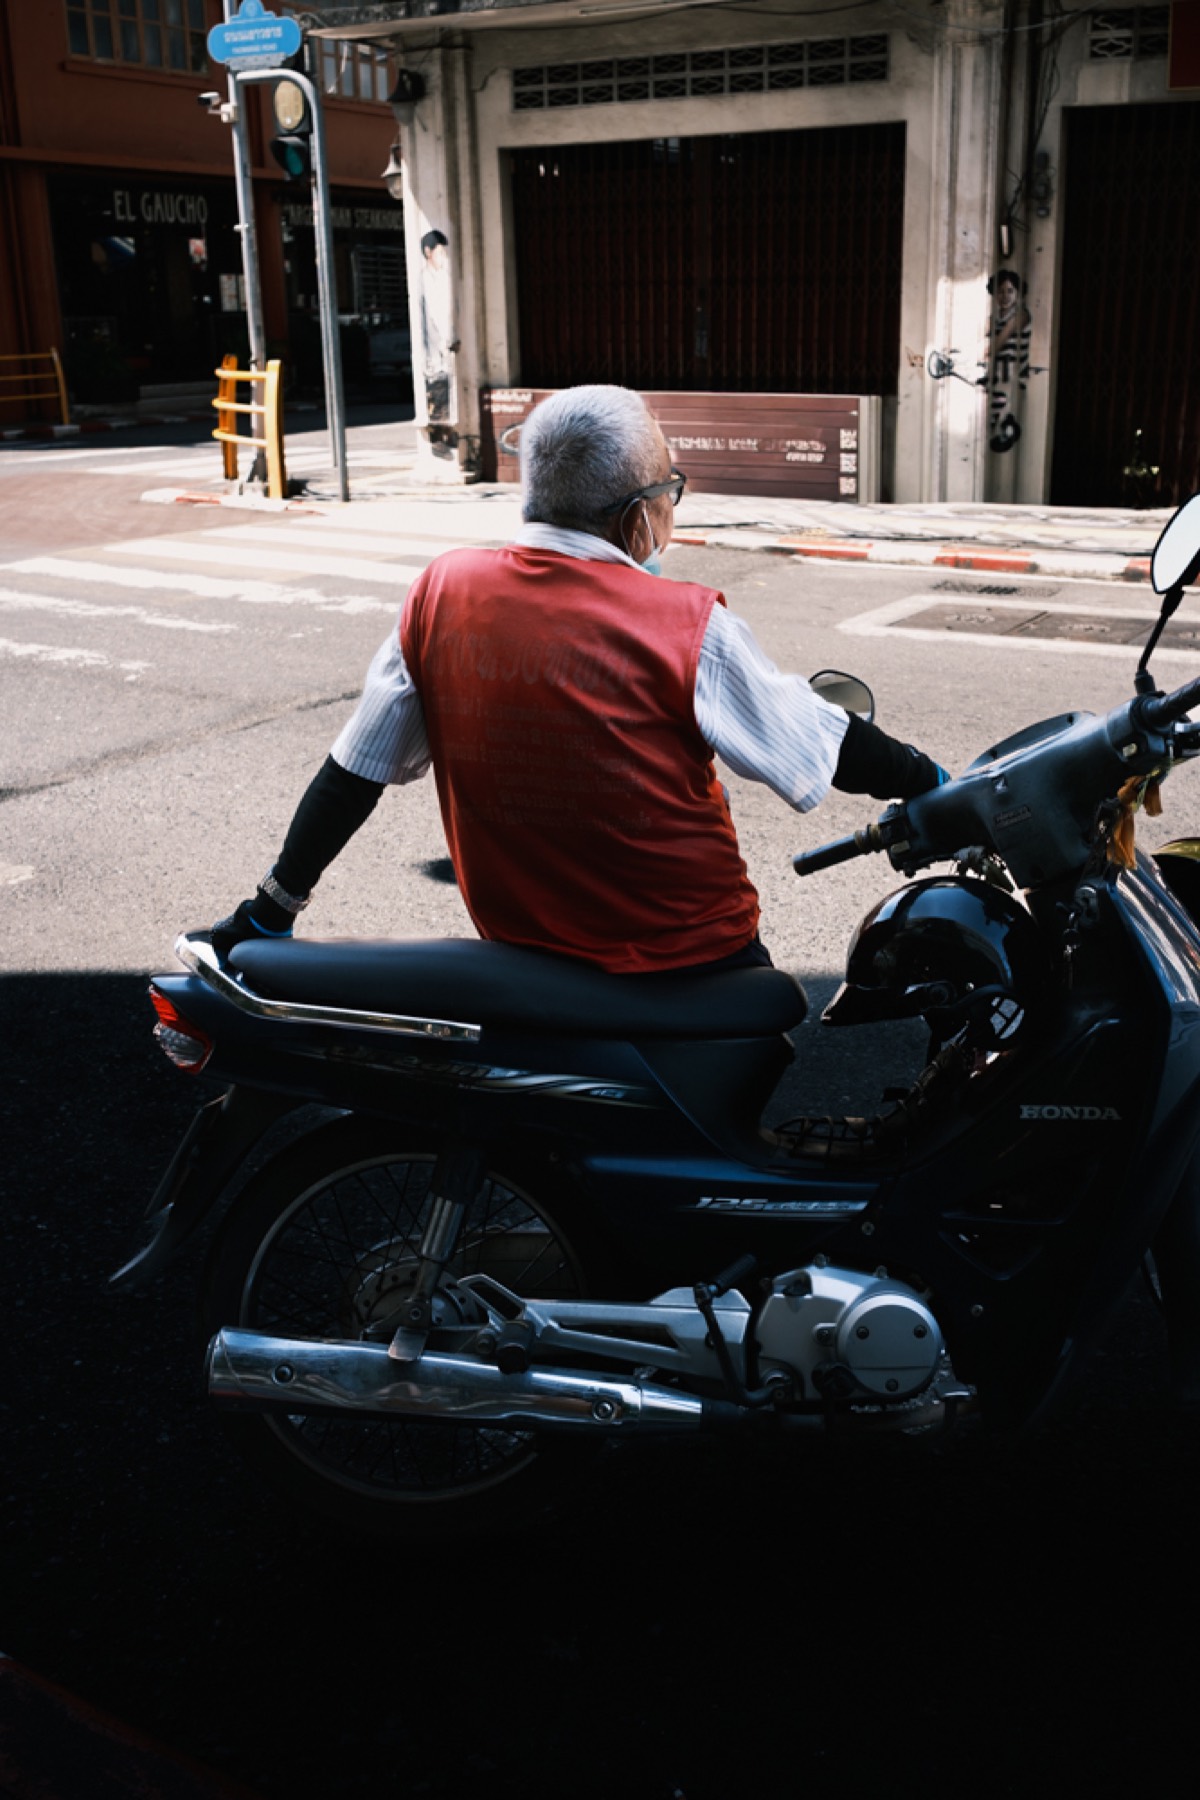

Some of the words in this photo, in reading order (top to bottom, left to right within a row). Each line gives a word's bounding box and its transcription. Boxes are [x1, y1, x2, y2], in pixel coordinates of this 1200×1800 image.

[113, 190, 137, 222] EL
[140, 192, 208, 224] GAUCHO
[1019, 1104, 1122, 1121] HONDA
[695, 1197, 769, 1211] 125
